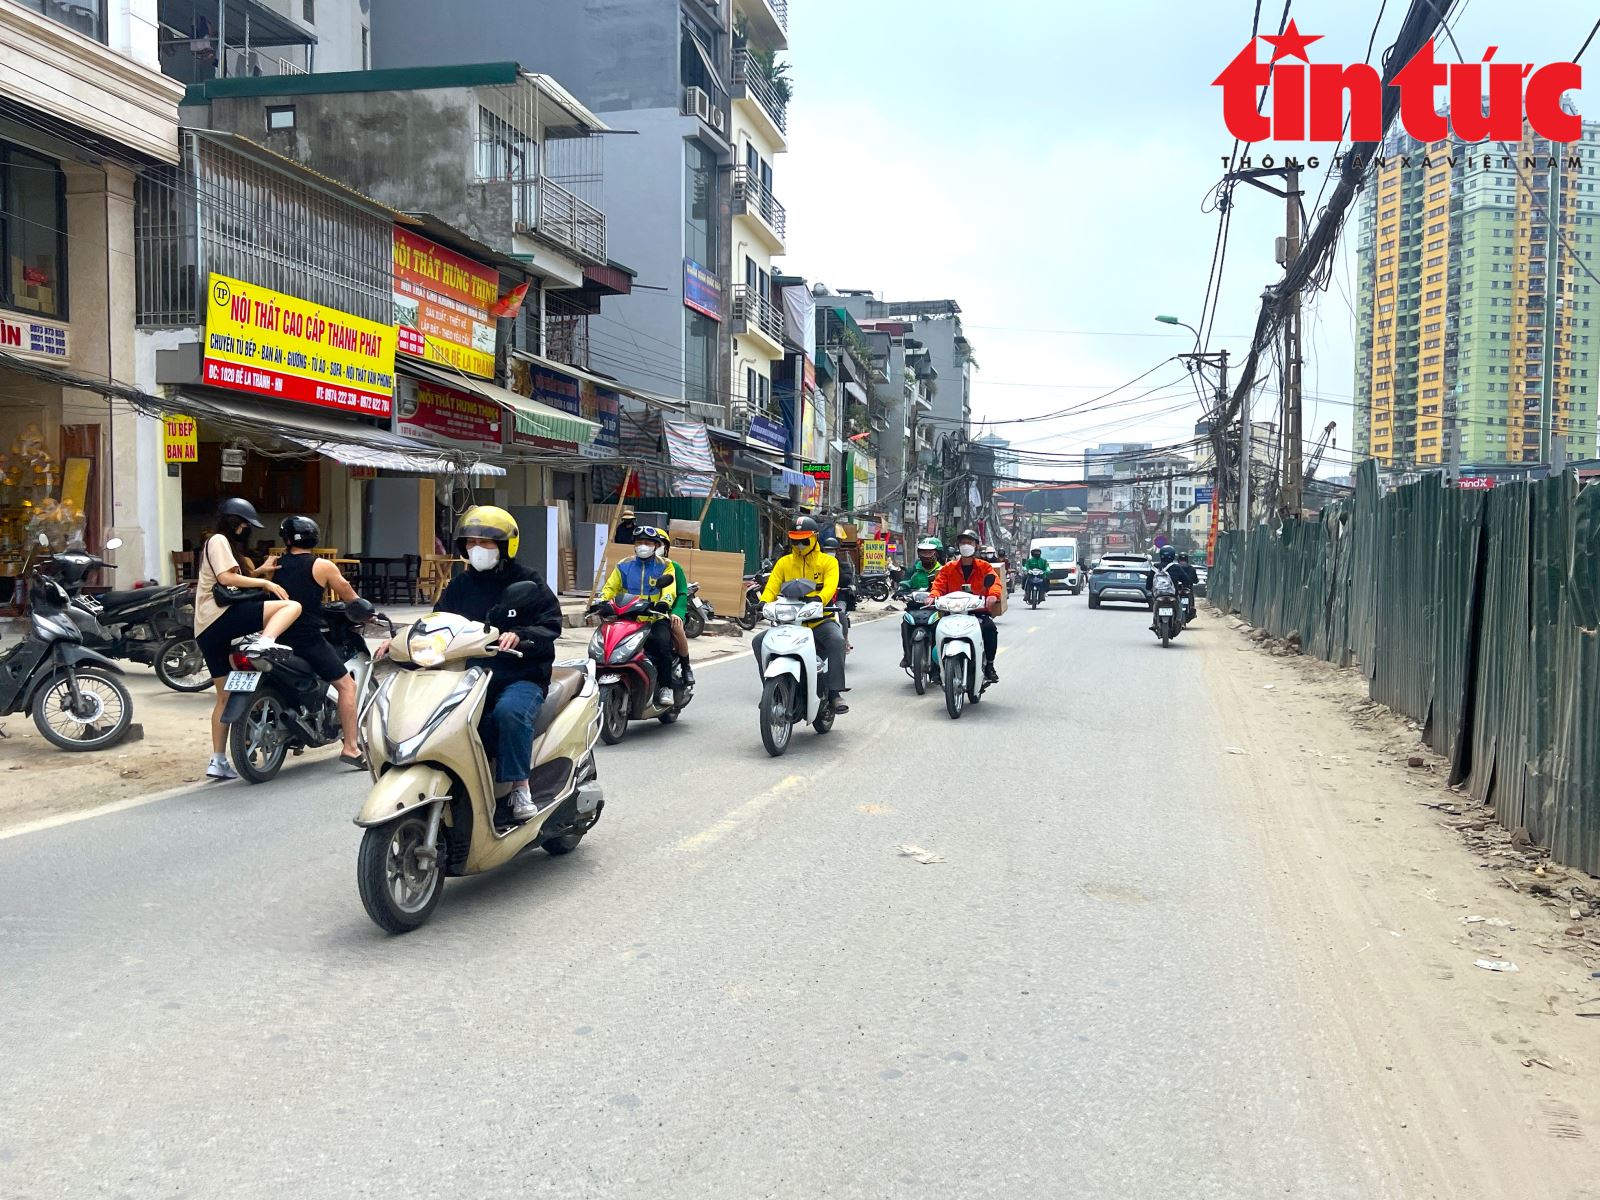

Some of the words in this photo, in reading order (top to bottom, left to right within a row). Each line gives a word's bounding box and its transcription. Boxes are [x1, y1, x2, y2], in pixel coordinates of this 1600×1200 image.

[393, 237, 411, 275] NỘI
[413, 245, 441, 281] THẤT
[442, 263, 469, 294] HƯNG
[471, 274, 498, 308] THỊNH
[216, 287, 227, 299] TP
[231, 291, 251, 329] NỘI
[255, 297, 281, 332] THẤT
[283, 309, 303, 338] CAO
[306, 310, 325, 343] CẤP
[328, 320, 358, 353] THÀNH
[360, 330, 382, 358] PHÁT
[210, 333, 234, 354] CHUYÊN
[236, 334, 244, 355] TỦ
[245, 337, 257, 358] BẾP
[261, 343, 273, 362] BÀN
[274, 345, 283, 364] ĂN
[244, 371, 252, 386] LA
[507, 608, 517, 618] D
[228, 681, 253, 690] 6526
